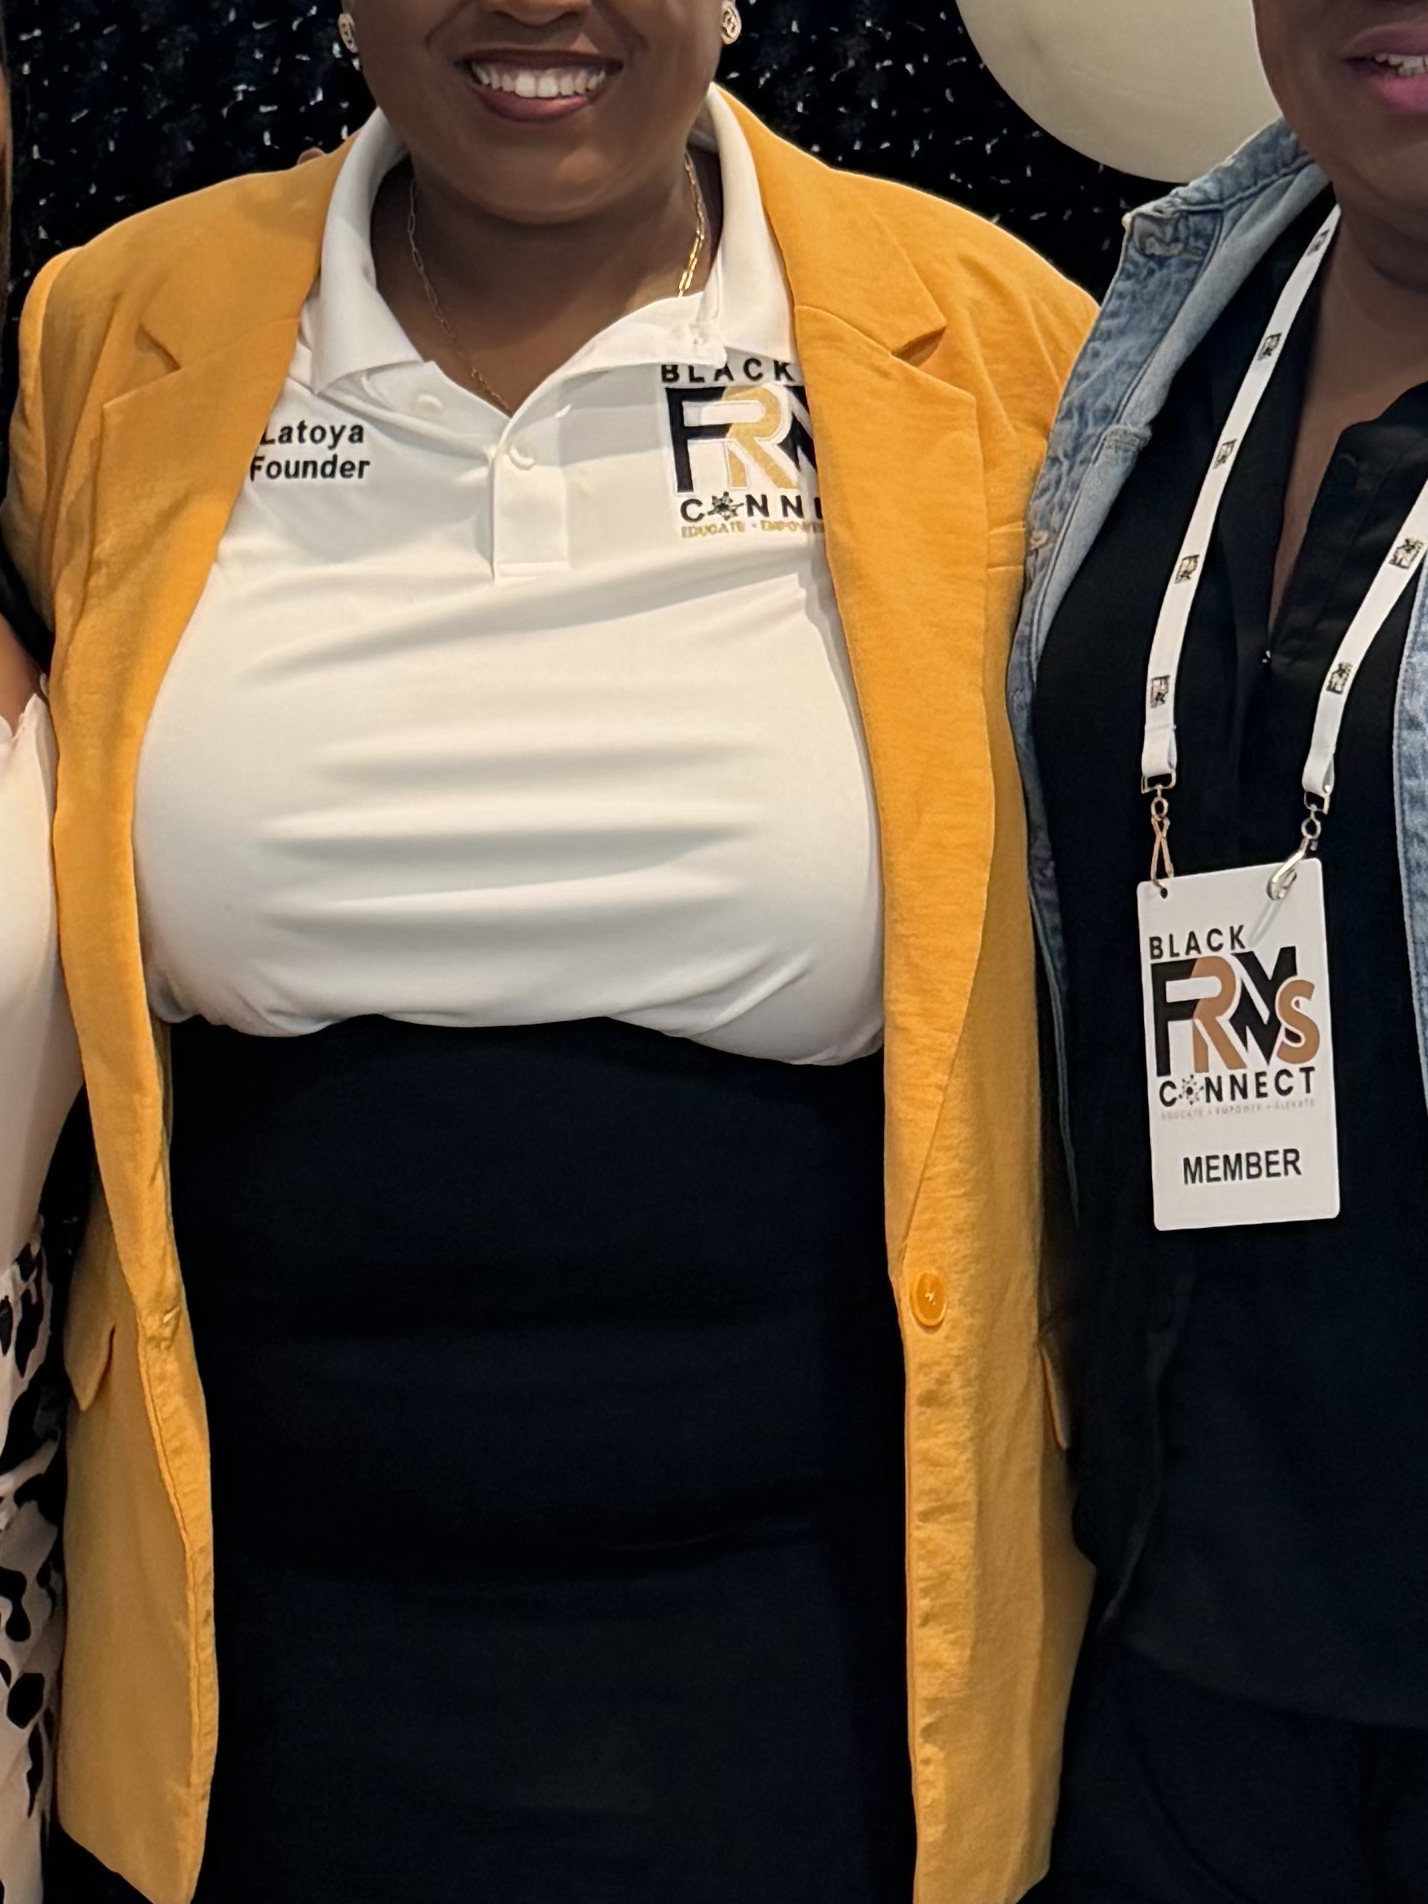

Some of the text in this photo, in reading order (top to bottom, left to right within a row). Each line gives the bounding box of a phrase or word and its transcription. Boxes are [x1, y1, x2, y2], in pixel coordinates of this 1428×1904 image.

[661, 358, 794, 383] BLACK
[250, 453, 371, 482] Founder
[1149, 925, 1245, 960] BLACK
[1151, 946, 1320, 1076] FRNS
[1159, 1066, 1315, 1107] CONNECT
[1183, 1148, 1302, 1185] MEMBER
